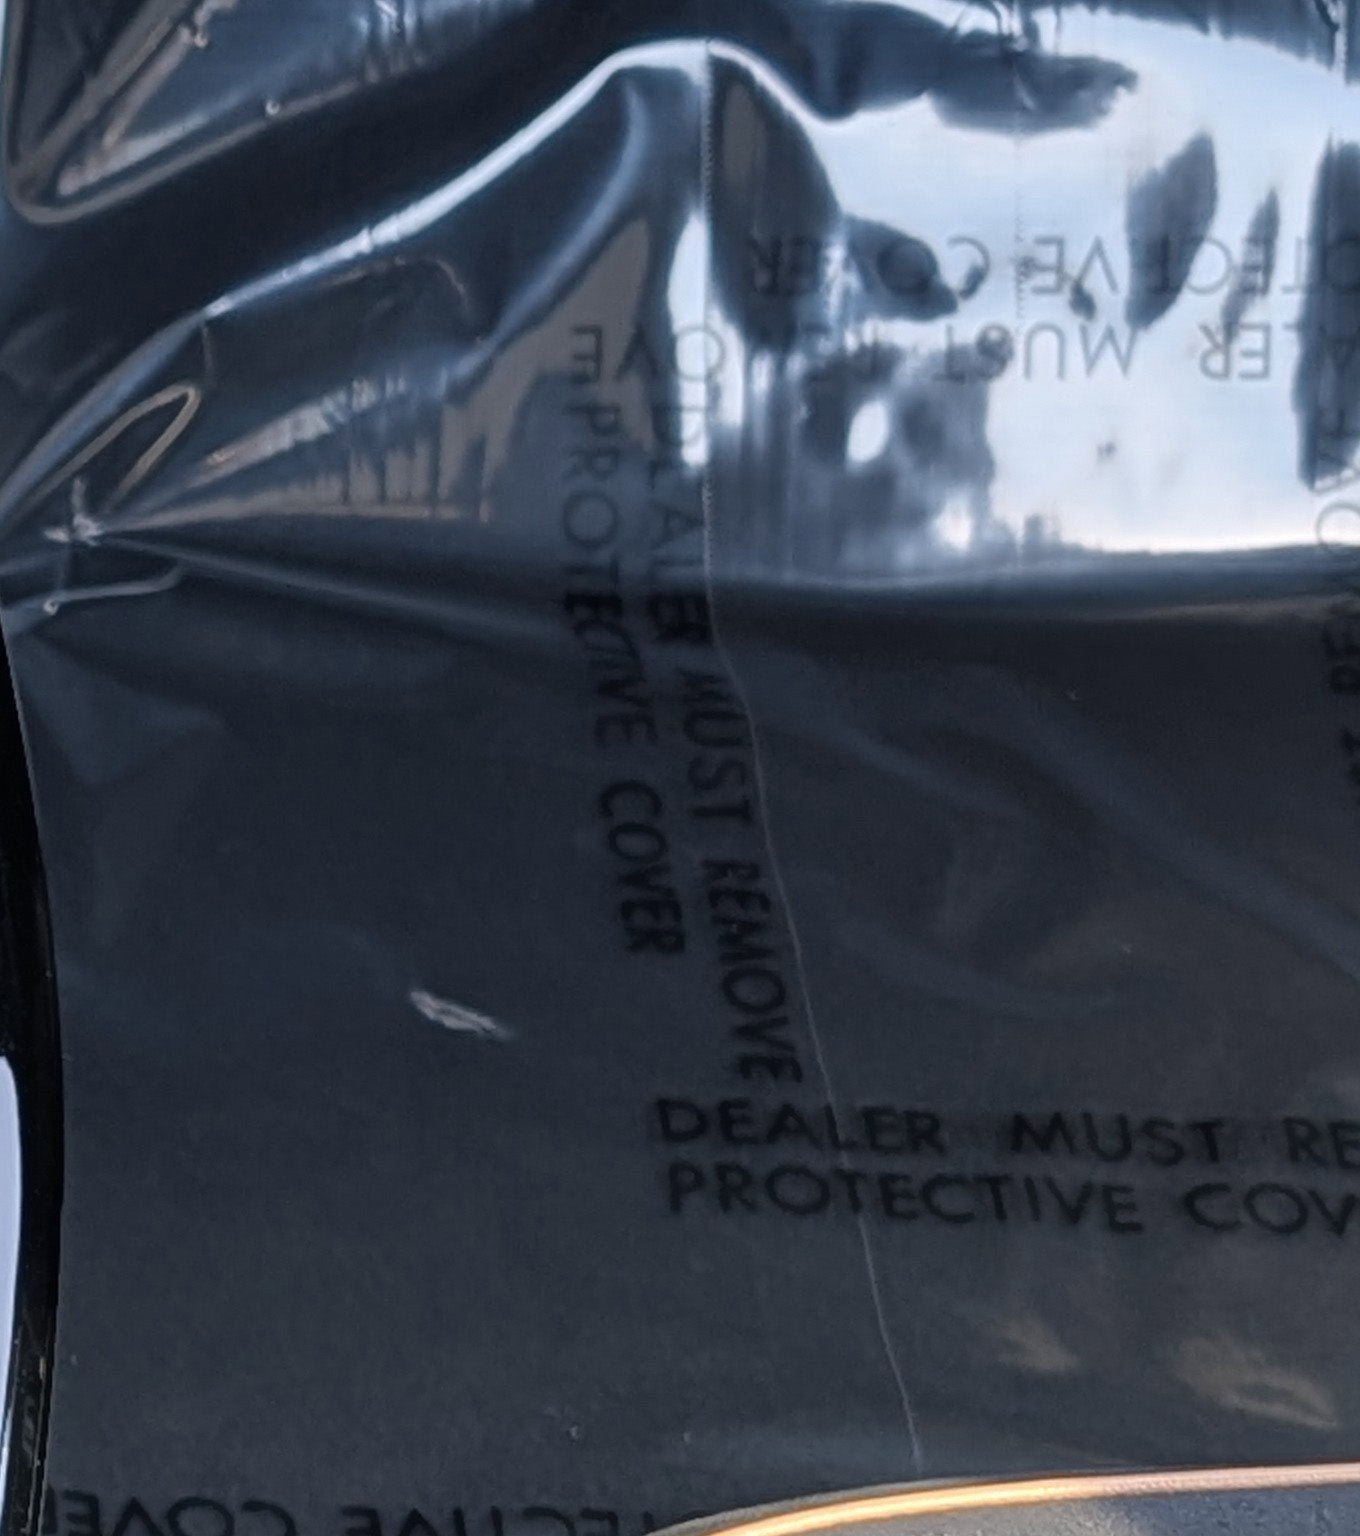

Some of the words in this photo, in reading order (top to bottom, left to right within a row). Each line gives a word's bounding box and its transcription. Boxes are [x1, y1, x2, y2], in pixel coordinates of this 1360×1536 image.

[936, 320, 1141, 382] MUST
[562, 402, 659, 749] PROTECTIVE
[679, 668, 753, 826] MUST
[598, 780, 686, 955] COVER
[701, 859, 804, 1083] REMOVE
[656, 1097, 946, 1156] DEALER
[1007, 1110, 1225, 1167] MUST
[666, 1161, 1144, 1235] PROTECTIVE
[1182, 1181, 1360, 1237] COV
